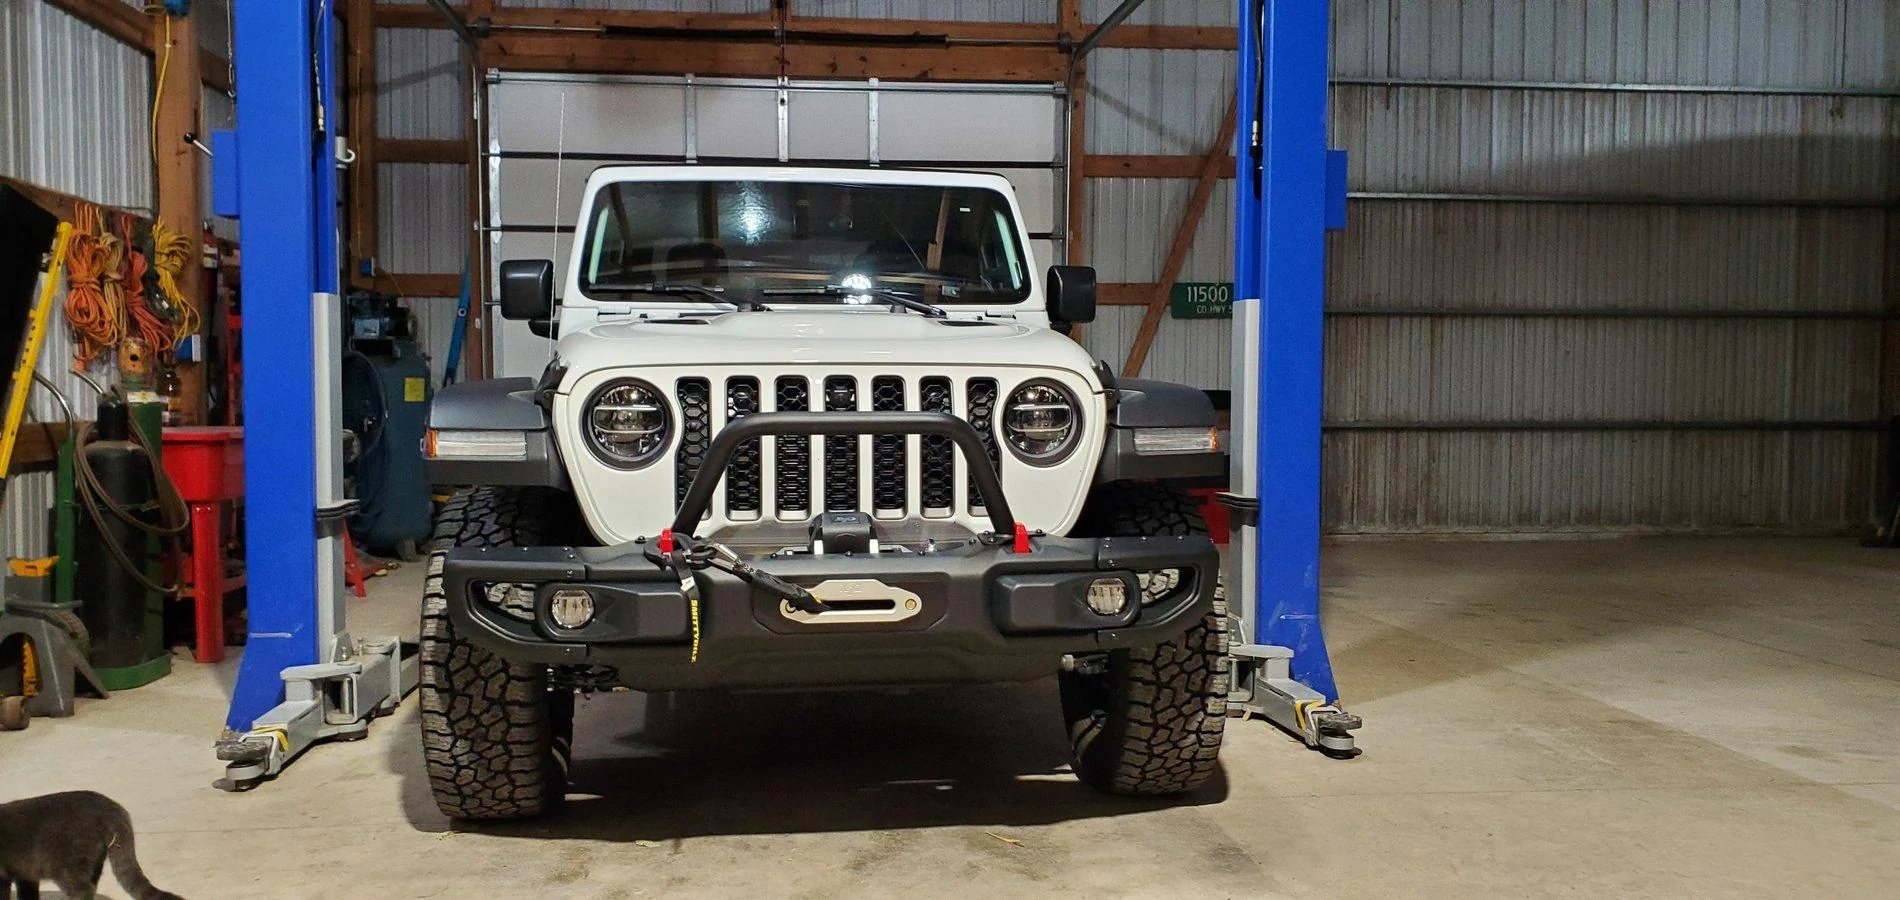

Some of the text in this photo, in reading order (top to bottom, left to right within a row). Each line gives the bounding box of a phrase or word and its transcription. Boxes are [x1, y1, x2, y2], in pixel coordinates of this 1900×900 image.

[1187, 286, 1228, 302] 11500
[1197, 305, 1207, 314] CO
[1210, 305, 1226, 313] HWY
[691, 599, 699, 662] SMITTYBILT
